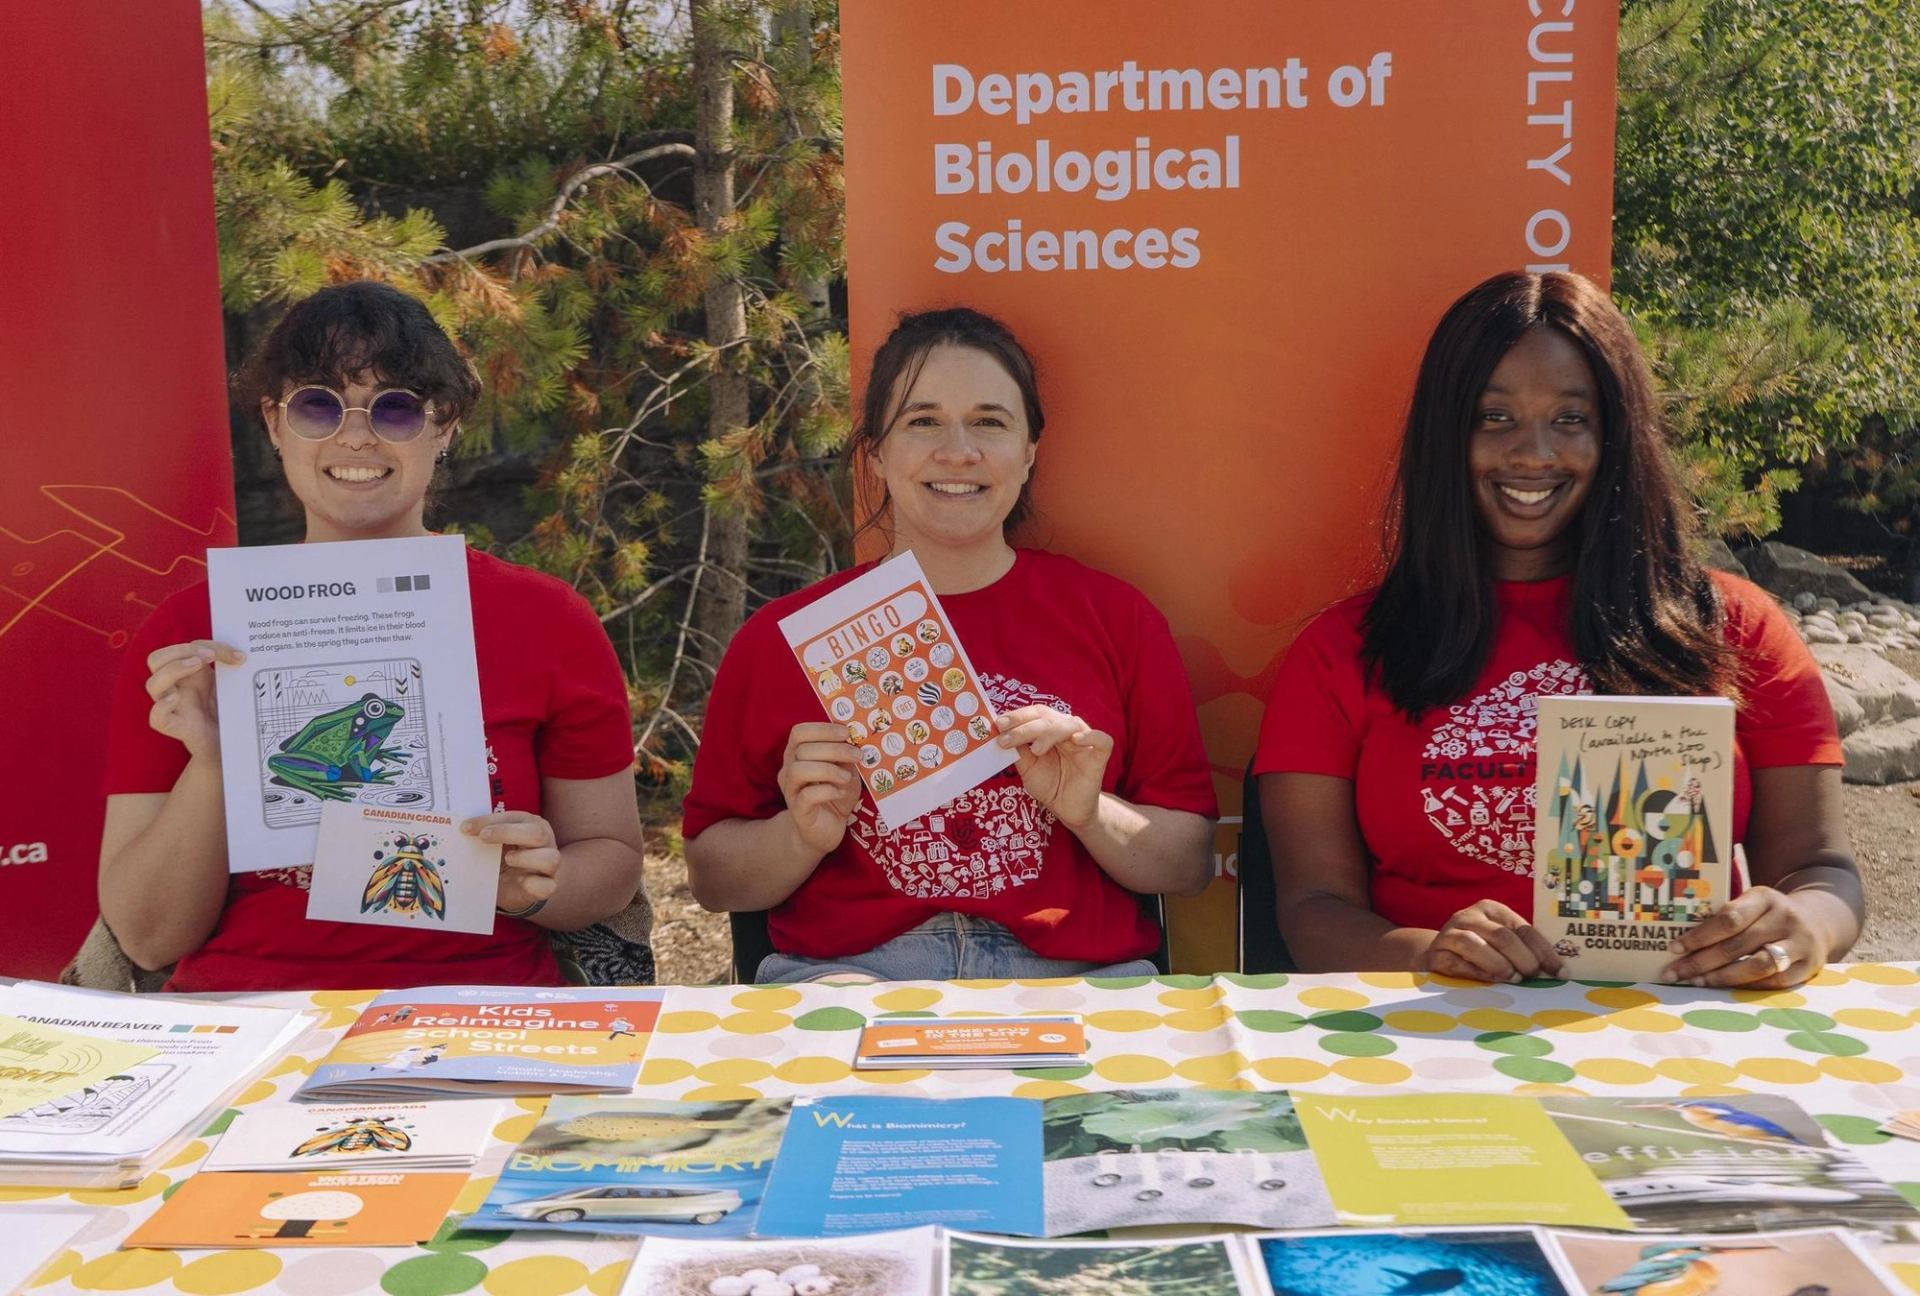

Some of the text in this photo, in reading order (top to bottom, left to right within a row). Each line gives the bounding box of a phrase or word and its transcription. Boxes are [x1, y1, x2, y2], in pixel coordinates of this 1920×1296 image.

[932, 52, 1392, 125] Department of
[933, 135, 1240, 201] Biological
[933, 219, 1201, 274] Sciences
[245, 582, 357, 602] WOOD FROG
[248, 619, 271, 629] Wood
[272, 618, 294, 629] frogs
[309, 615, 337, 624] survive
[337, 613, 370, 624] freezing.
[371, 611, 393, 620] These
[393, 609, 415, 620] frogs
[249, 631, 281, 642] produce
[292, 627, 338, 638] anti-freeze.
[345, 624, 366, 634] limits
[366, 624, 378, 632] ice
[378, 623, 386, 631] in
[386, 621, 403, 631] their
[405, 620, 426, 630] blood
[826, 604, 902, 660] BINGO
[250, 632, 414, 653] and organs. In the spring they can then thaw.
[895, 700, 914, 714] FREE
[1559, 715, 1637, 730] DESK COPY
[1580, 726, 1708, 752] (available in the
[1630, 748, 1673, 762] North
[363, 808, 415, 821] CANADIAN
[415, 813, 452, 825] CICADA
[0, 841, 48, 867] .ca
[1565, 922, 1638, 939] ALBERTA
[1584, 938, 1668, 951] COLOURING
[478, 1005, 553, 1017] Kids
[101, 1021, 163, 1031] BEAVER
[411, 1015, 600, 1030] Reimagine
[402, 1027, 528, 1041] School
[467, 1040, 598, 1055] Streets
[308, 1105, 377, 1113] CANADIAN
[1314, 1105, 1373, 1125] Why
[812, 1110, 868, 1129] What
[885, 1121, 967, 1131] Biomimicry?
[317, 1174, 405, 1184] WESTERN
